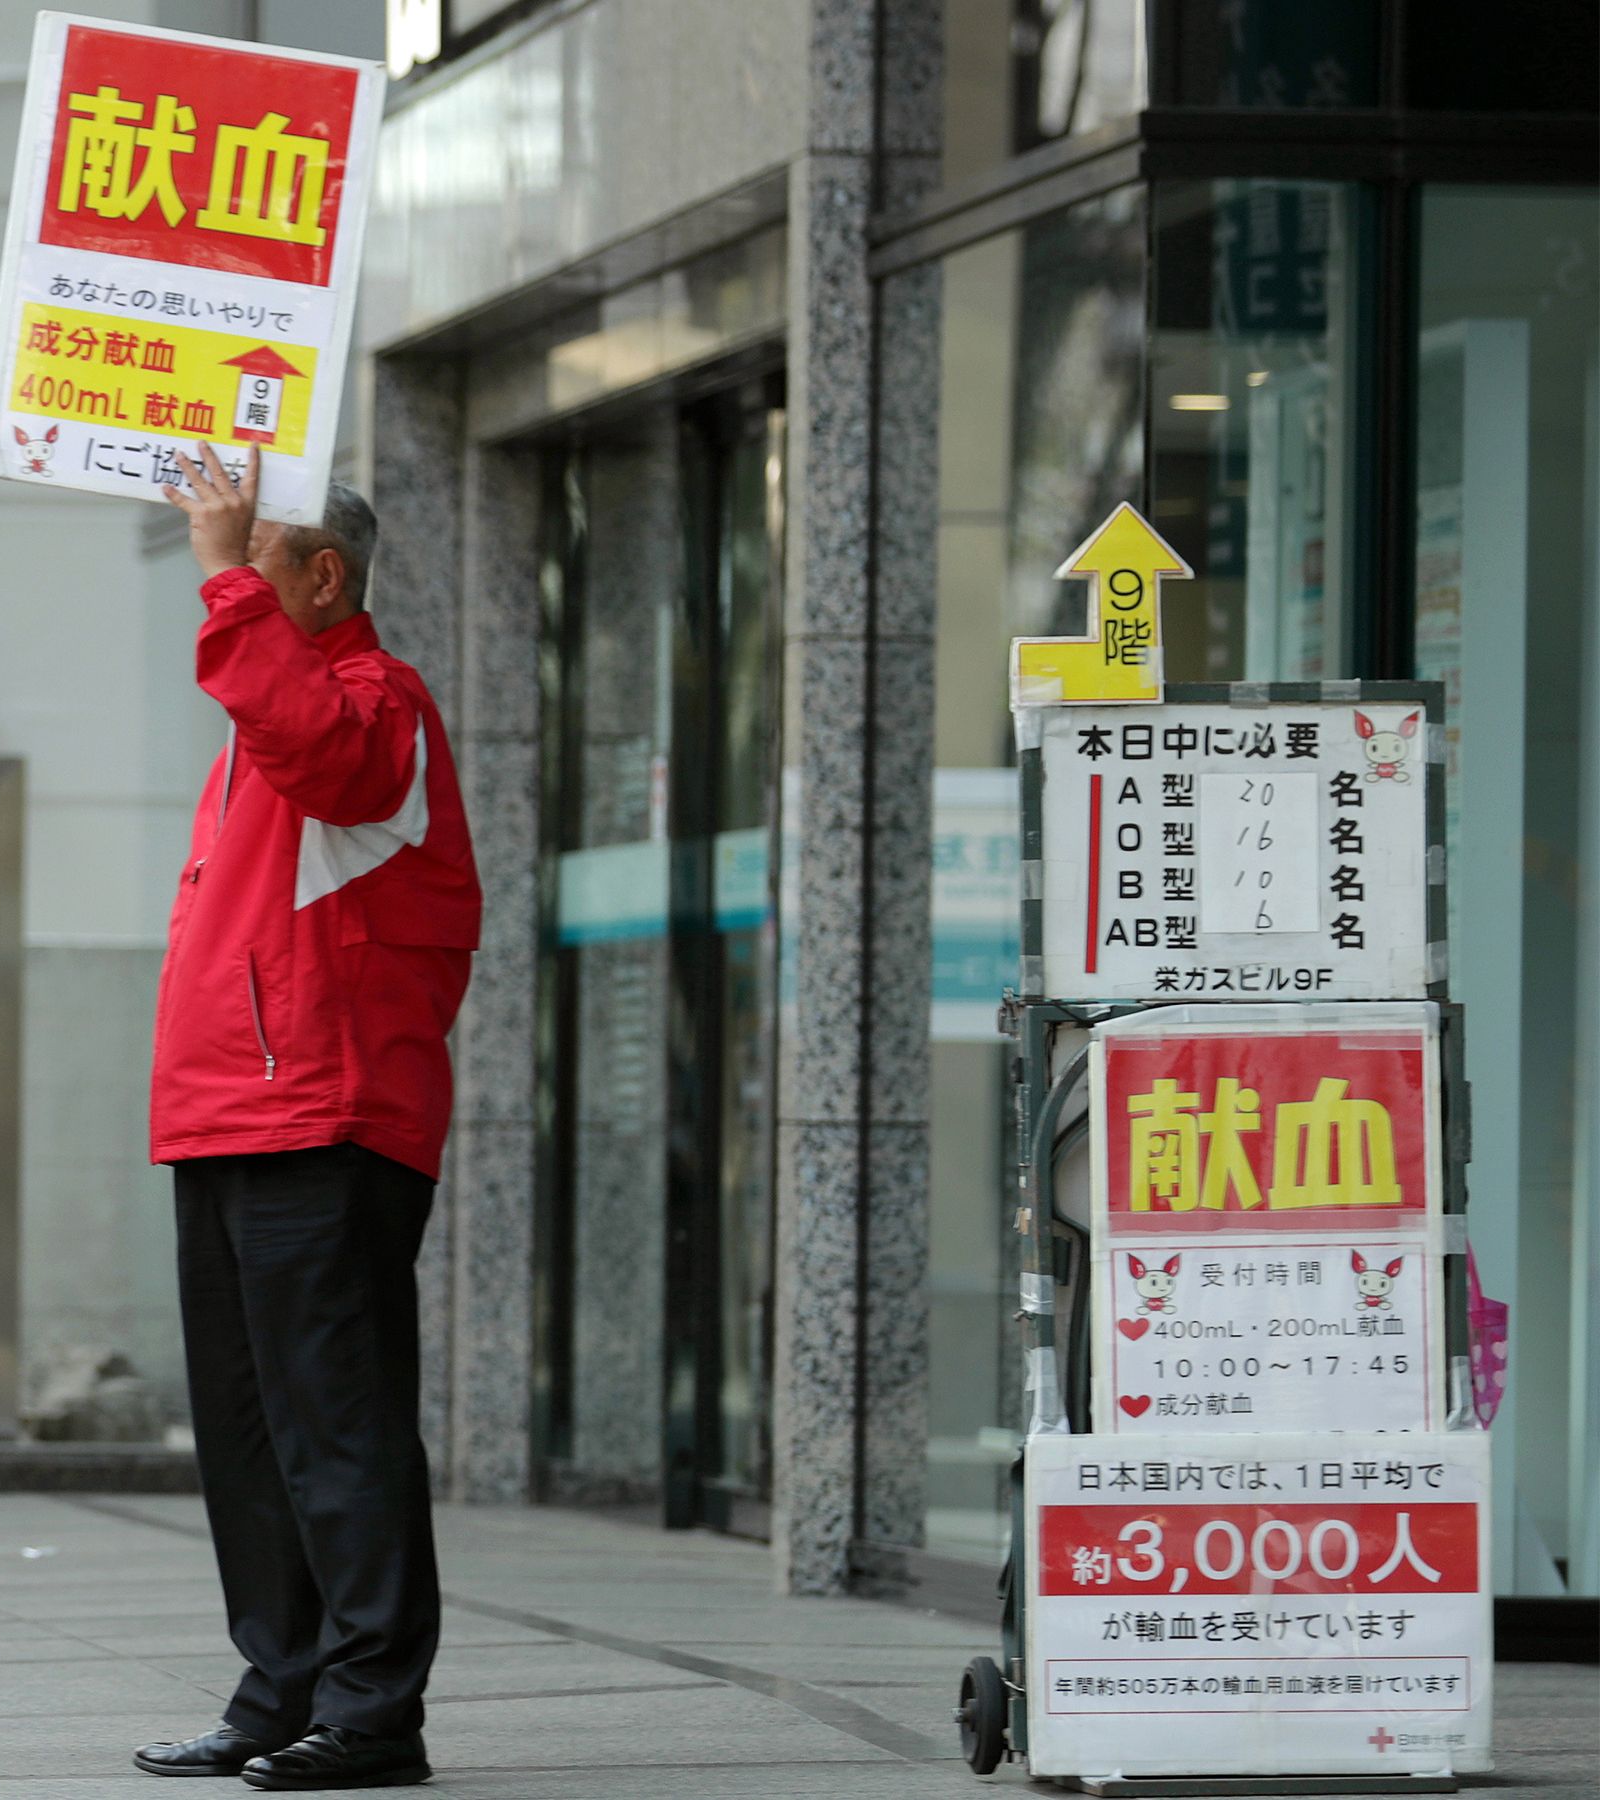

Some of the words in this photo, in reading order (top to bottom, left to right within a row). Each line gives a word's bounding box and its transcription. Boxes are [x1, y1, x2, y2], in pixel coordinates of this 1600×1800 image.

[57, 86, 331, 248] 献血
[48, 274, 294, 333] あなたの思いやりで
[25, 320, 177, 375] 成分献血
[18, 372, 128, 421] 400mL
[142, 392, 216, 436] 献血
[244, 379, 269, 428] 9階
[1105, 568, 1151, 667] 9階
[1078, 723, 1320, 760] 本日中に必要
[1118, 777, 1141, 805] A
[1162, 774, 1195, 808] 型
[1239, 778, 1274, 806] 20
[1329, 771, 1364, 808] 名
[1162, 822, 1196, 857] 型
[1237, 821, 1273, 851] 16
[1329, 818, 1364, 855] 名
[1119, 871, 1144, 900] B
[1162, 868, 1196, 902] 型
[1234, 870, 1272, 889] 10
[1330, 866, 1365, 902] 名
[1330, 914, 1365, 950] 名
[1154, 966, 1334, 992] 栄ガスビル9F
[1126, 1076, 1402, 1212] 献血
[1201, 1261, 1322, 1287] 受付時間
[1155, 1393, 1253, 1417] 成分献血
[1078, 1461, 1444, 1492] 日本国内では、1日平均で
[1071, 1512, 1443, 1594] 約3,000人
[1102, 1610, 1416, 1643] が輸血を受けています
[1054, 1674, 1461, 1696] 年間約505万本の輸血用血液を届けています
